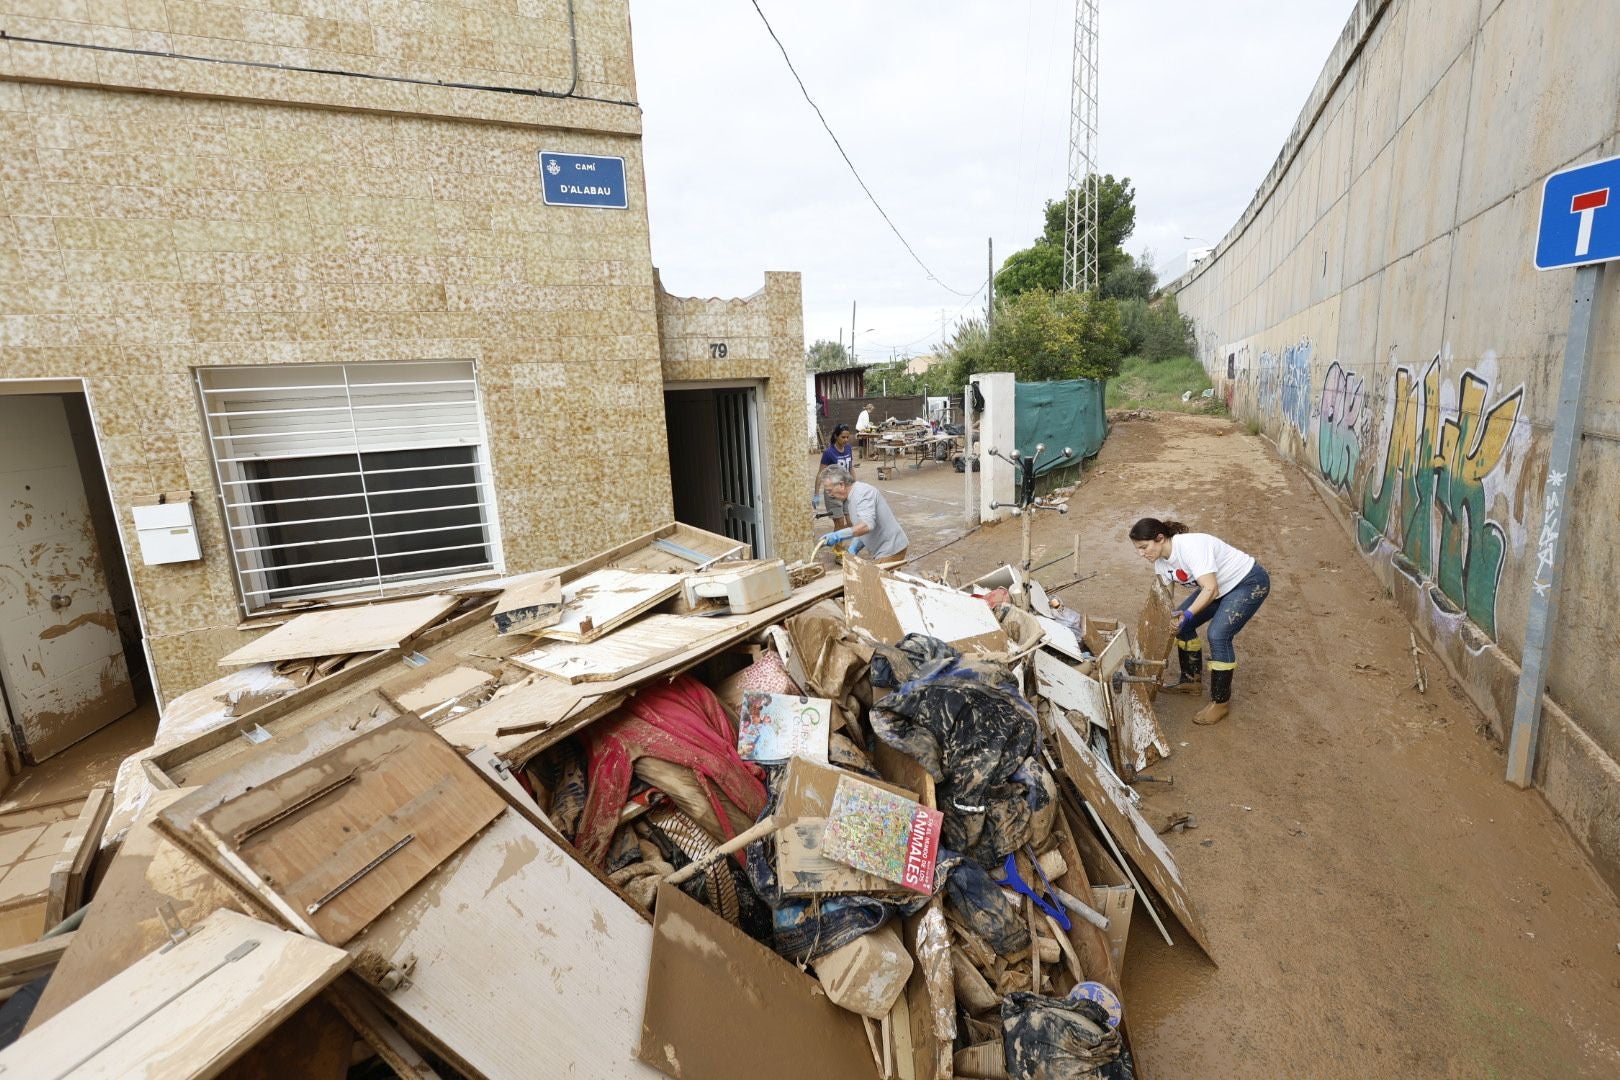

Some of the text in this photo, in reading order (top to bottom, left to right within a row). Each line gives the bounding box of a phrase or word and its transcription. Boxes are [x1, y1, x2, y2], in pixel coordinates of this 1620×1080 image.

[575, 162, 596, 171] CAMÍ
[560, 184, 611, 196] D'ALABAU
[709, 342, 728, 359] 79
[906, 811, 929, 885] ANIMALES
[922, 837, 930, 858] MUNDO
[920, 860, 927, 868] DE
